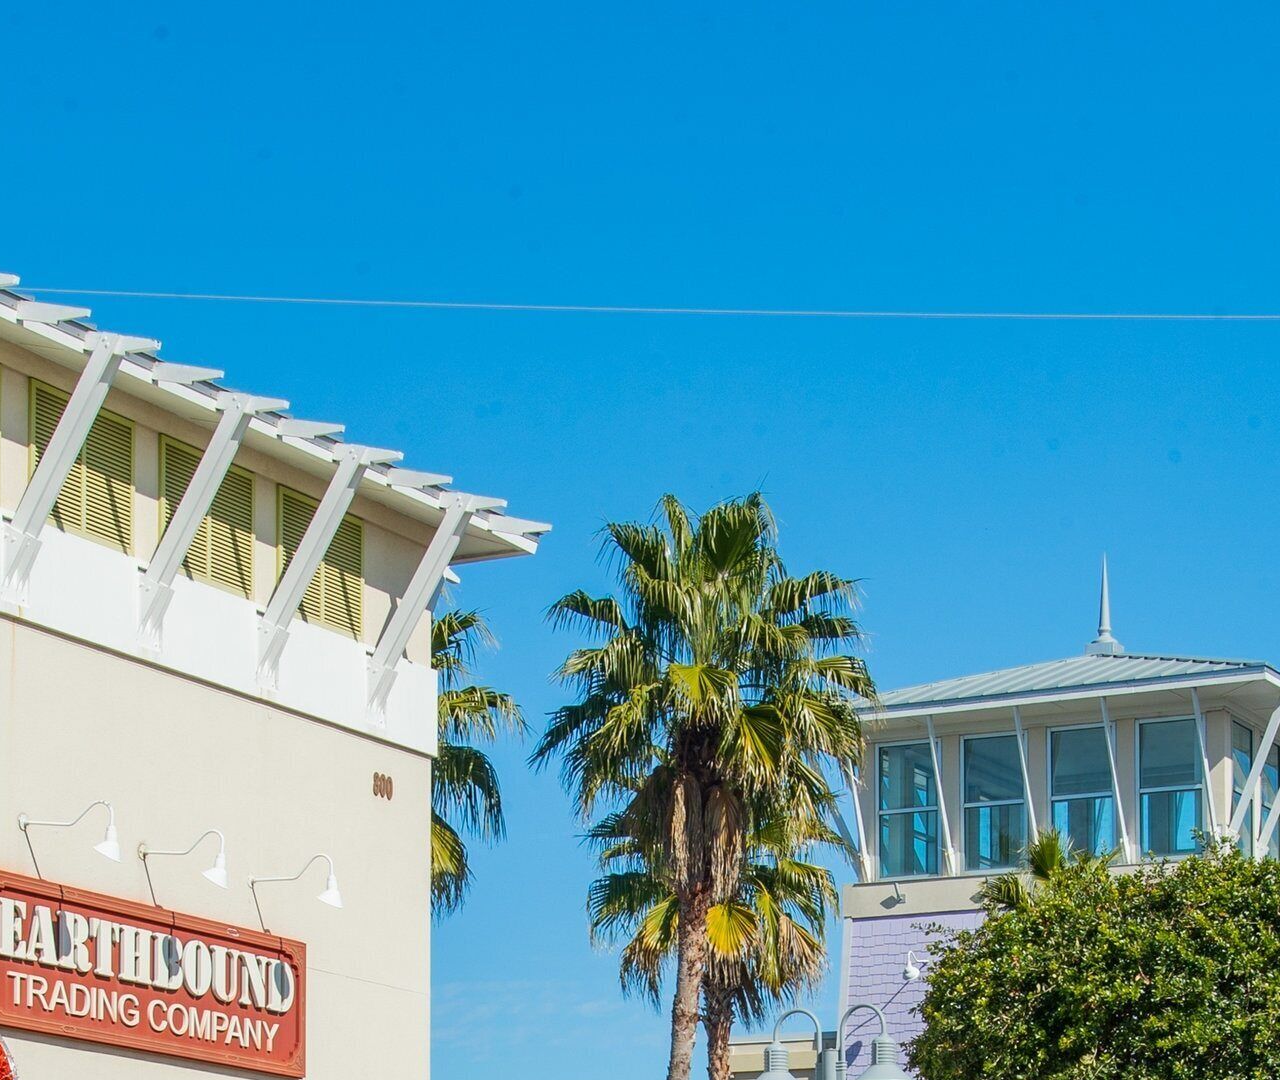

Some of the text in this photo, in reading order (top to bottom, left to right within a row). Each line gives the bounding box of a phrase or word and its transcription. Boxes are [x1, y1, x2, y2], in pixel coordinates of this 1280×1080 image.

[373, 771, 394, 801] 800
[7, 970, 280, 1054] TRADING COMPANY
